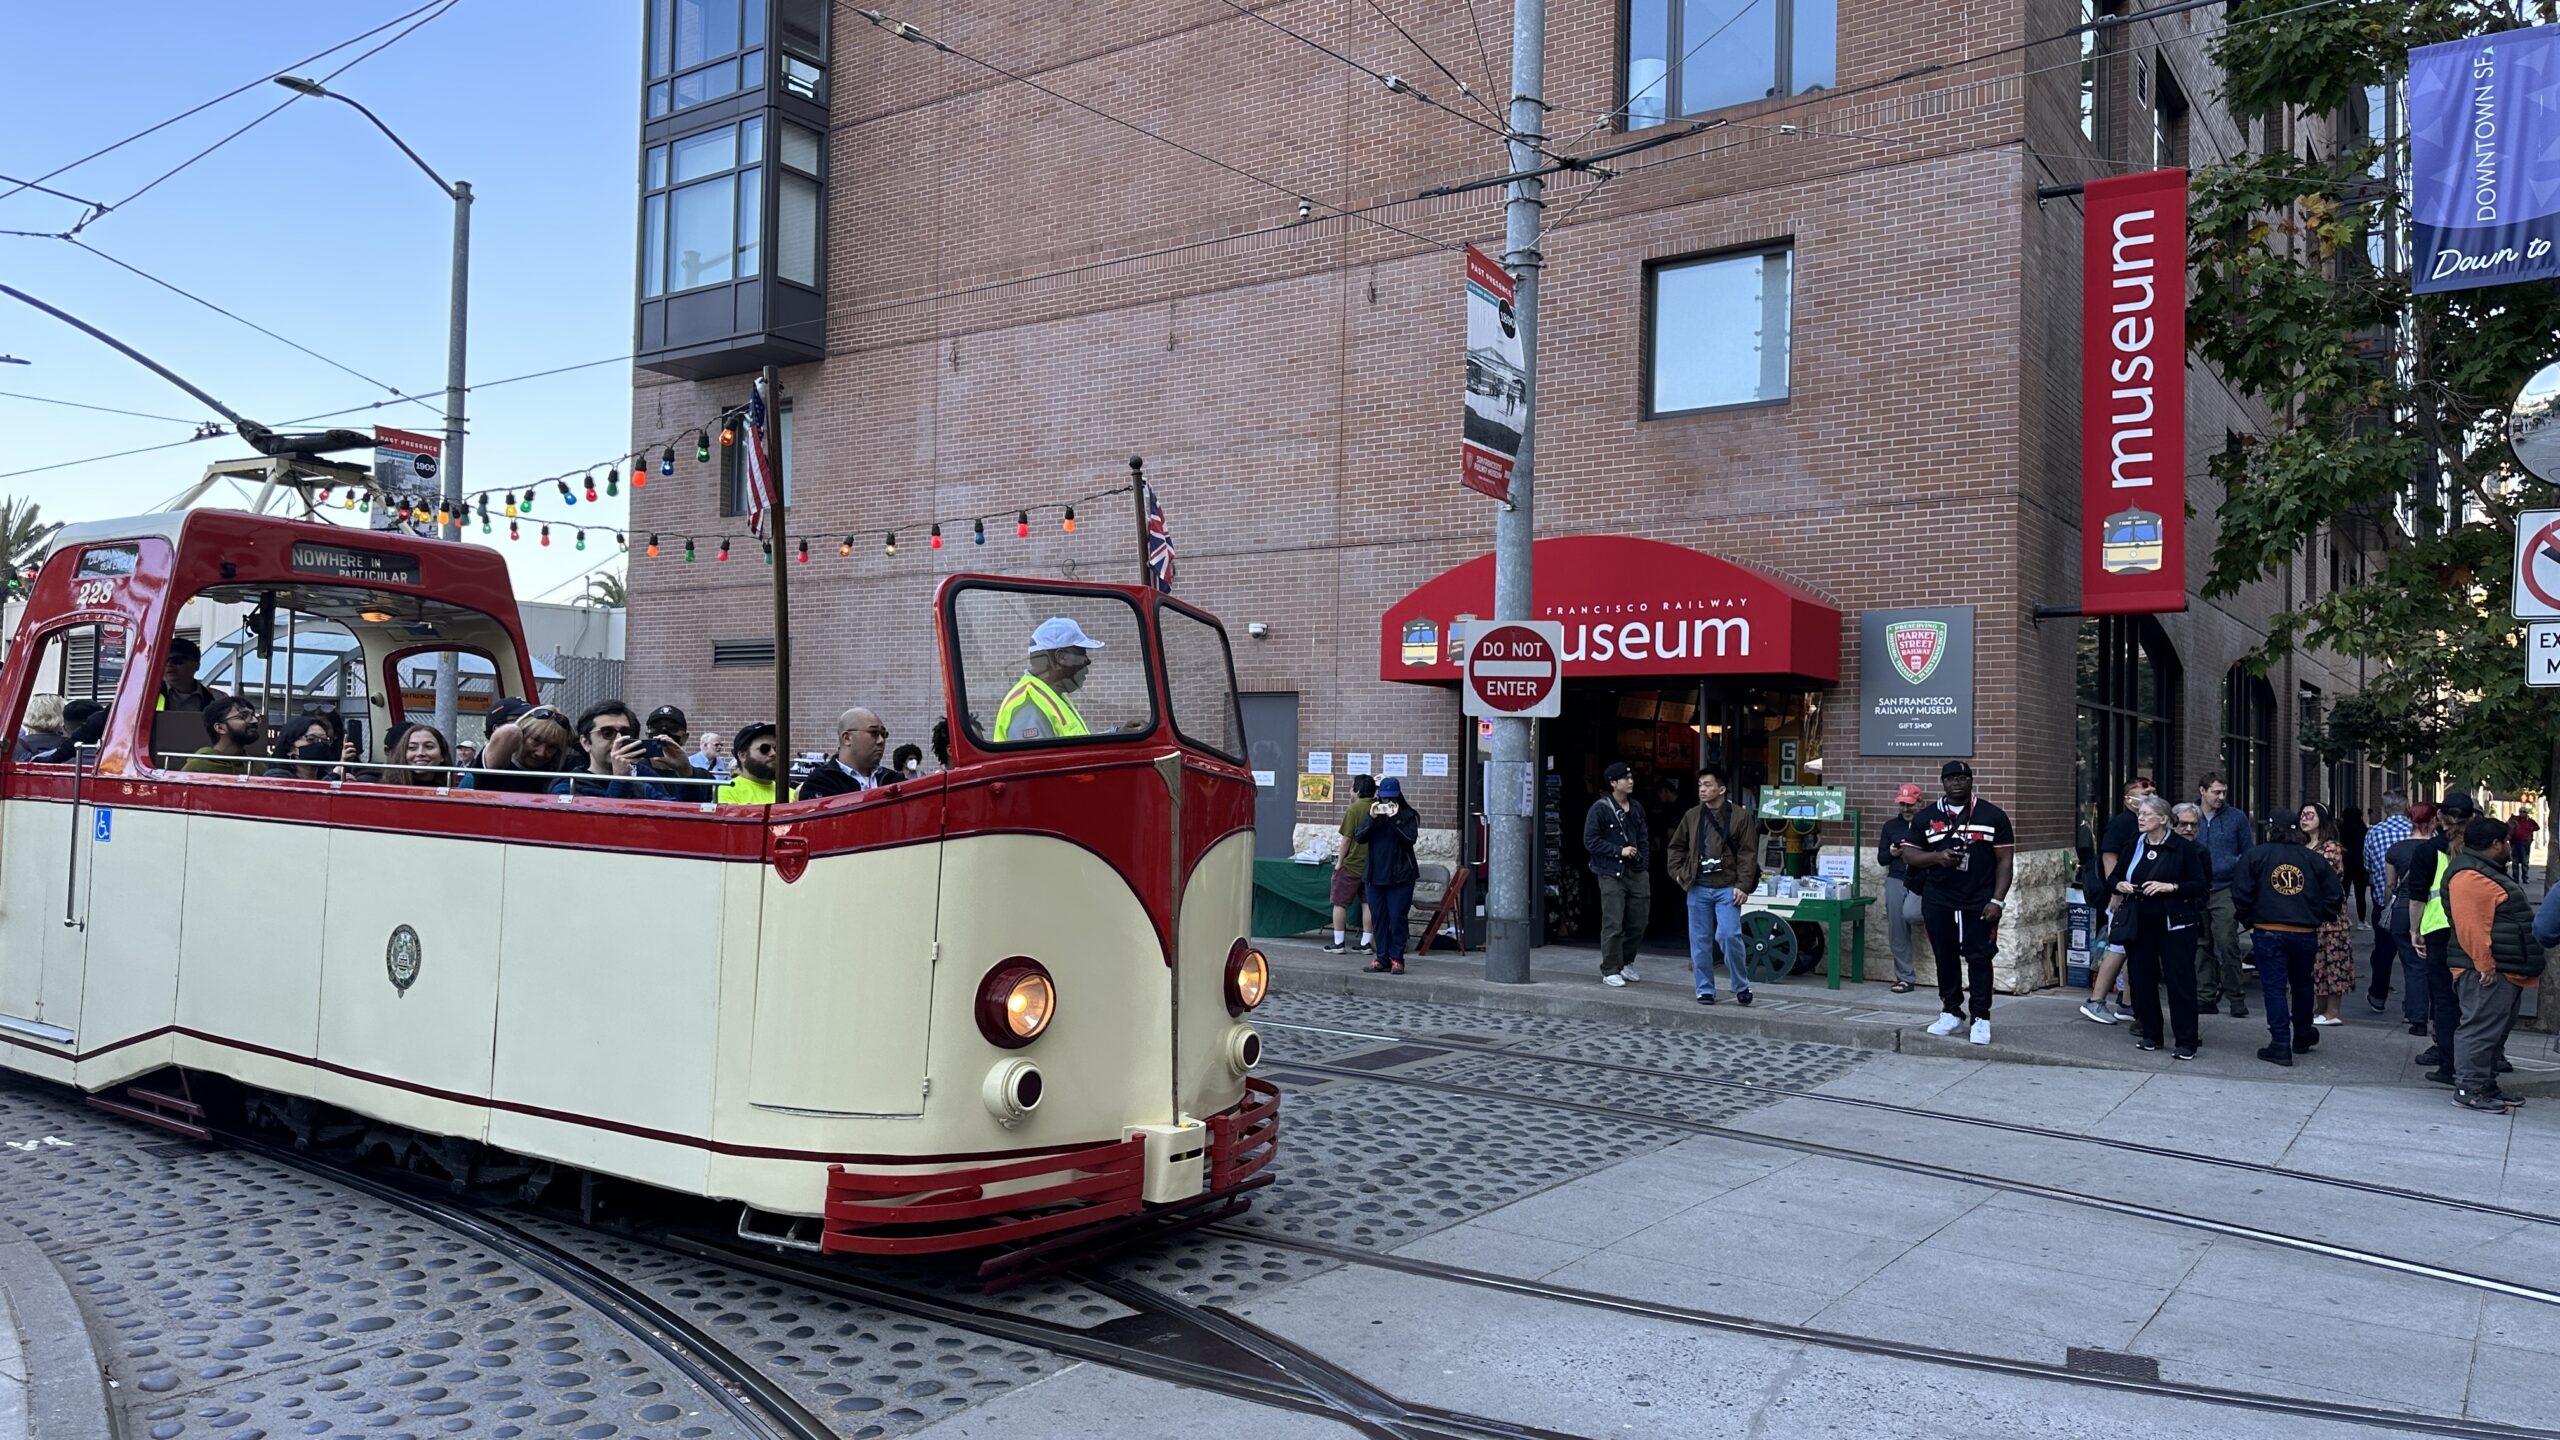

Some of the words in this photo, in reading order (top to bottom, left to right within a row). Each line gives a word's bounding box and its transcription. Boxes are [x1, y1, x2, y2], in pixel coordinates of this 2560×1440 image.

[2474, 56, 2495, 78] SF
[2475, 85, 2497, 221] DOWNTOWN
[2432, 246, 2520, 280] Down
[2527, 237, 2552, 259] to
[1471, 262, 1485, 277] PAST
[1486, 272, 1512, 298] PRESENCE
[2111, 210, 2154, 488] museum
[380, 435, 399, 444] PAST
[401, 439, 438, 452] PRESENCE
[415, 462, 436, 472] 1905
[292, 548, 363, 568] NOWHERE
[371, 558, 381, 568] IN
[339, 569, 408, 584] PARTICULAR
[77, 581, 115, 604] 228
[1546, 603, 1648, 616] FRANCISCO
[1663, 598, 1748, 610] RAILWAY
[1561, 617, 1750, 662] useum
[1897, 631, 1936, 641] MARKET
[1899, 640, 1934, 649] STREET
[2540, 632, 2560, 648] EX
[1483, 642, 1504, 657] DO
[1512, 642, 1543, 657] NOT
[2547, 658, 2560, 674] M
[1487, 681, 1537, 696] ENTER
[1879, 697, 1897, 706] SAN
[1899, 696, 1953, 706] FRANCISCO
[1875, 707, 1915, 715] RAILWAY
[1916, 706, 1957, 715] MUSEUM
[2281, 871, 2294, 889] SF
